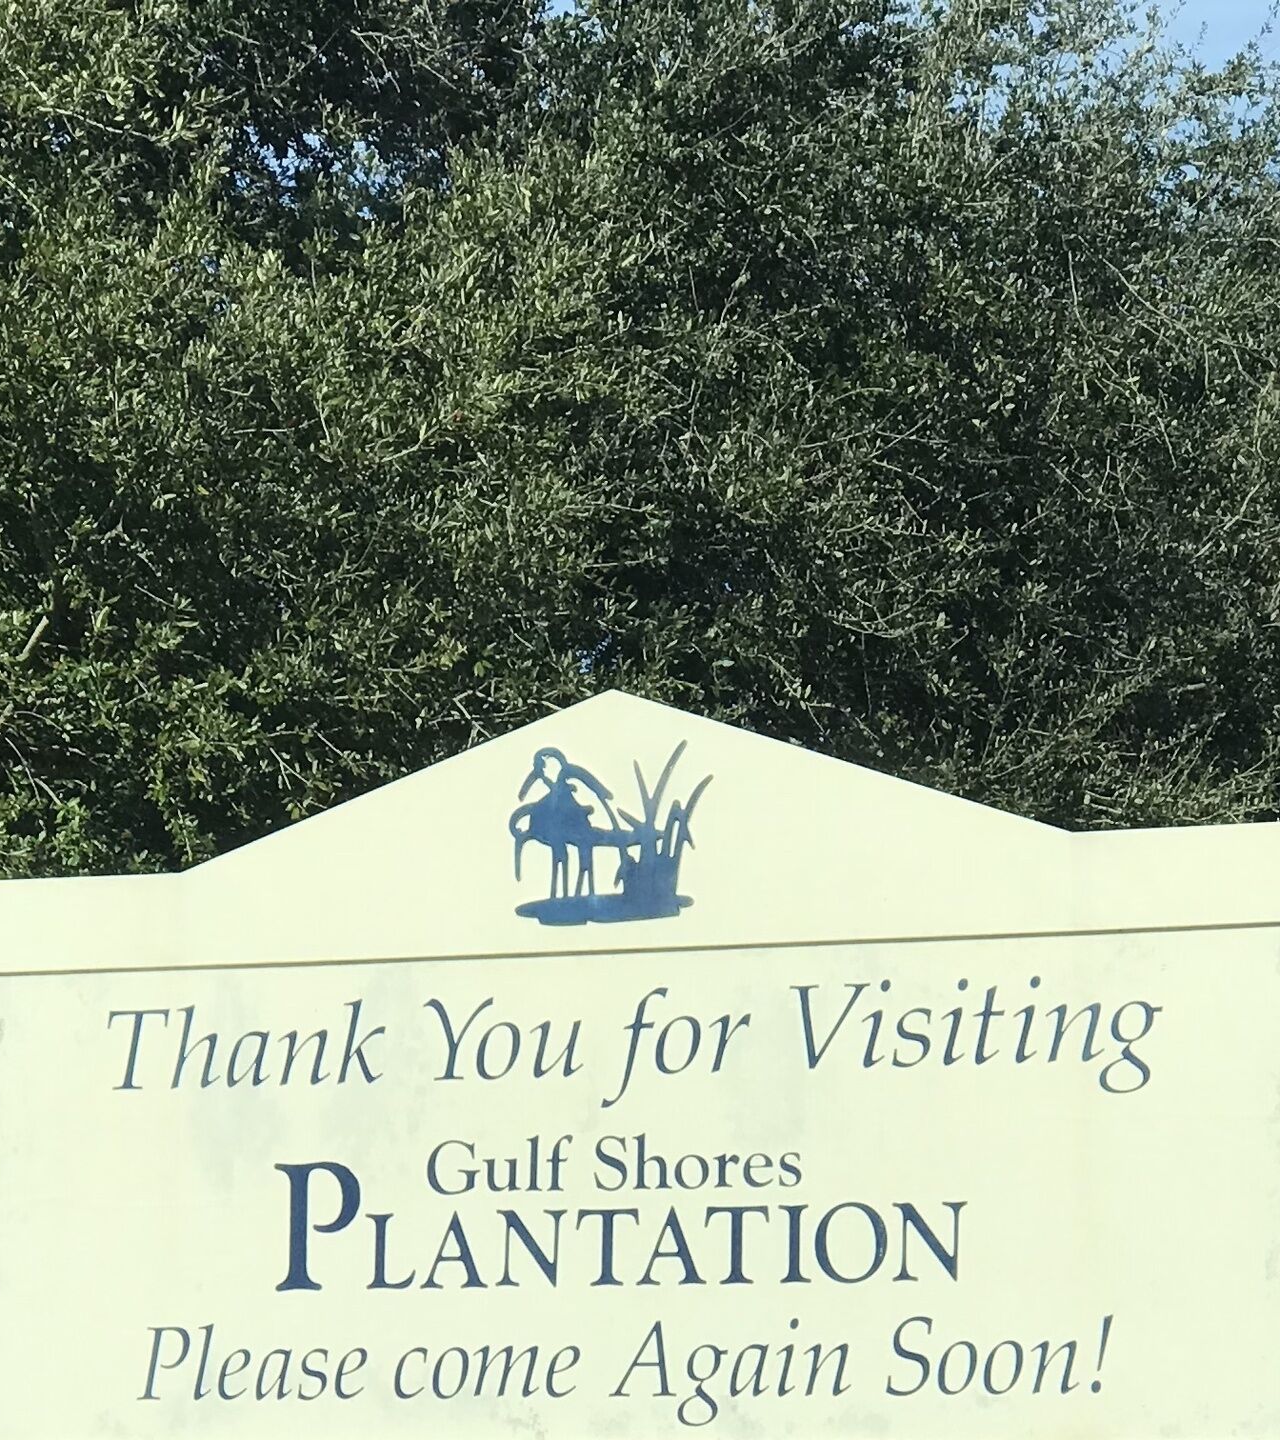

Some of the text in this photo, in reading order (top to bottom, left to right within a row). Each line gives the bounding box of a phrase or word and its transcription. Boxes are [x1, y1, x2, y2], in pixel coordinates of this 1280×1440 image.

[107, 975, 1164, 1109] Thank You for Visiting
[426, 1132, 803, 1196] Gulf Shores
[273, 1160, 969, 1293] PLANTATION
[136, 1313, 1114, 1428] Please come Again Soon!
